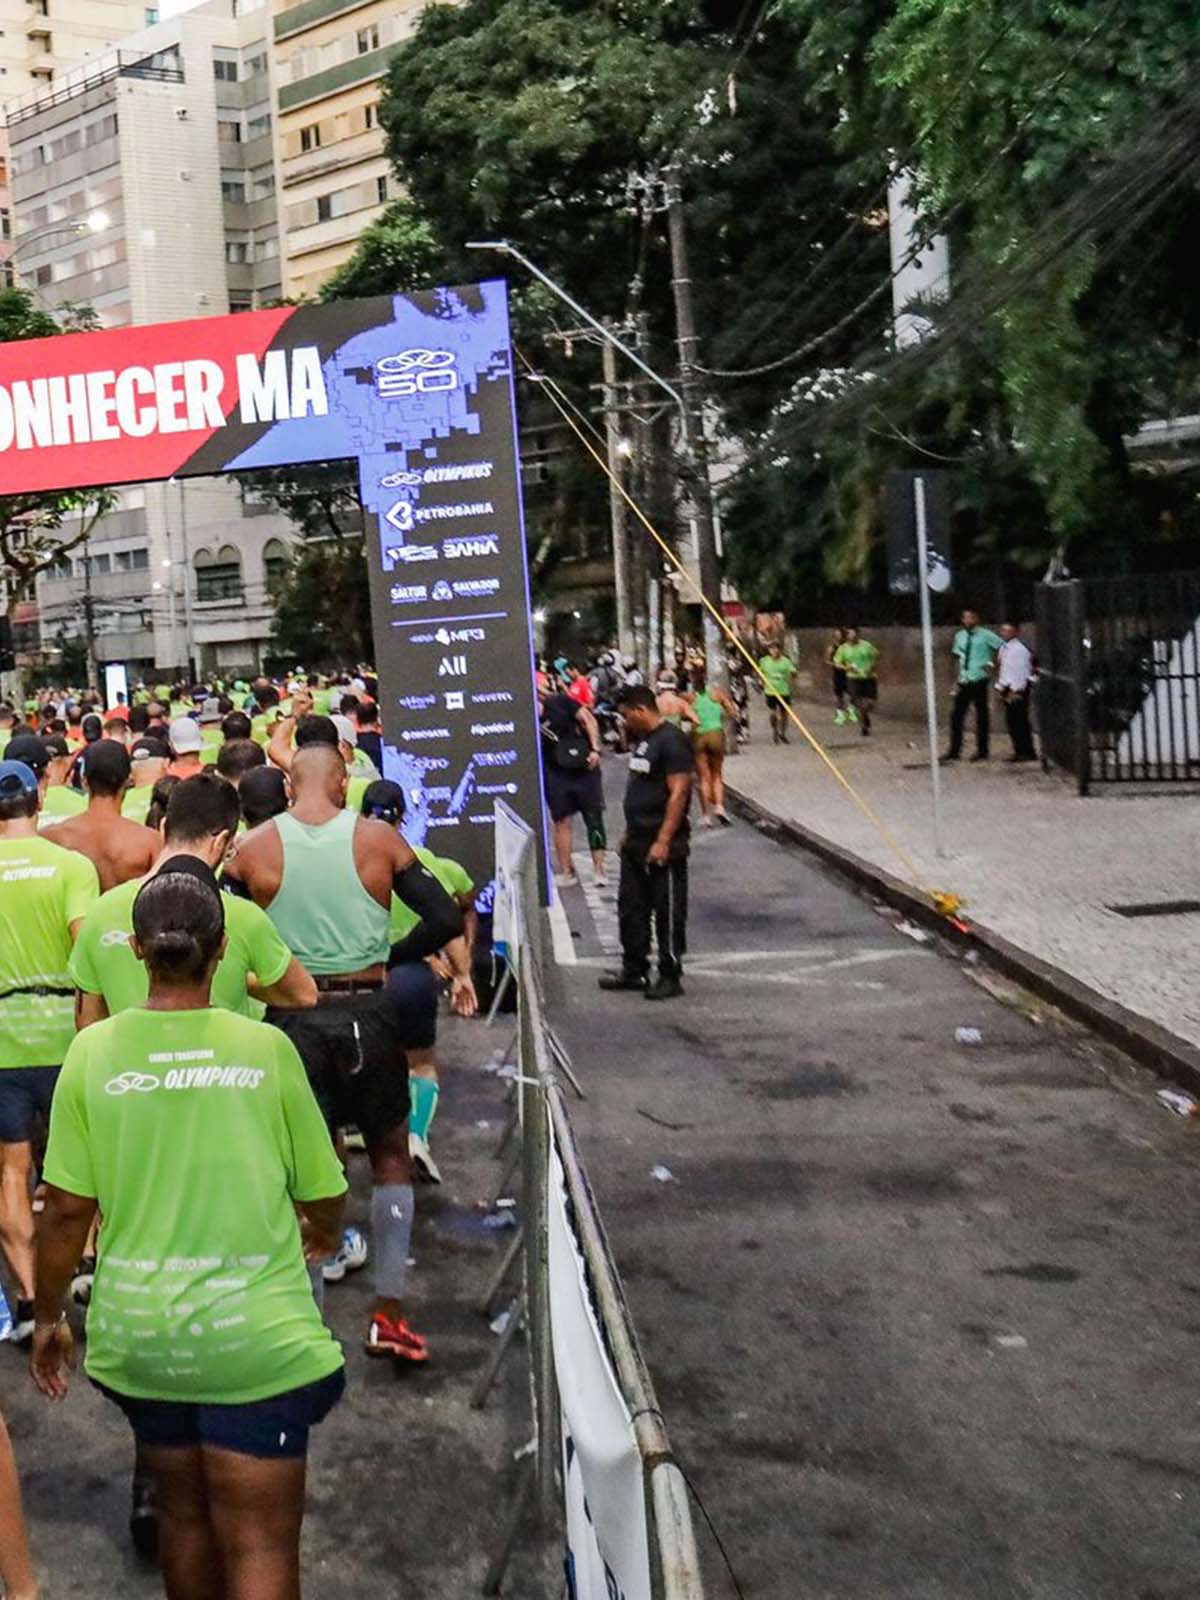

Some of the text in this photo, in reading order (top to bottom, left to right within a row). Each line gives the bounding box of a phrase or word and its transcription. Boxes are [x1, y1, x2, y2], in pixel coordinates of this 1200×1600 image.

[236, 346, 329, 424] MA
[377, 368, 458, 398] 50
[415, 502, 494, 520] PETROBAHIA
[164, 1066, 265, 1090] OLYMPIKUS
